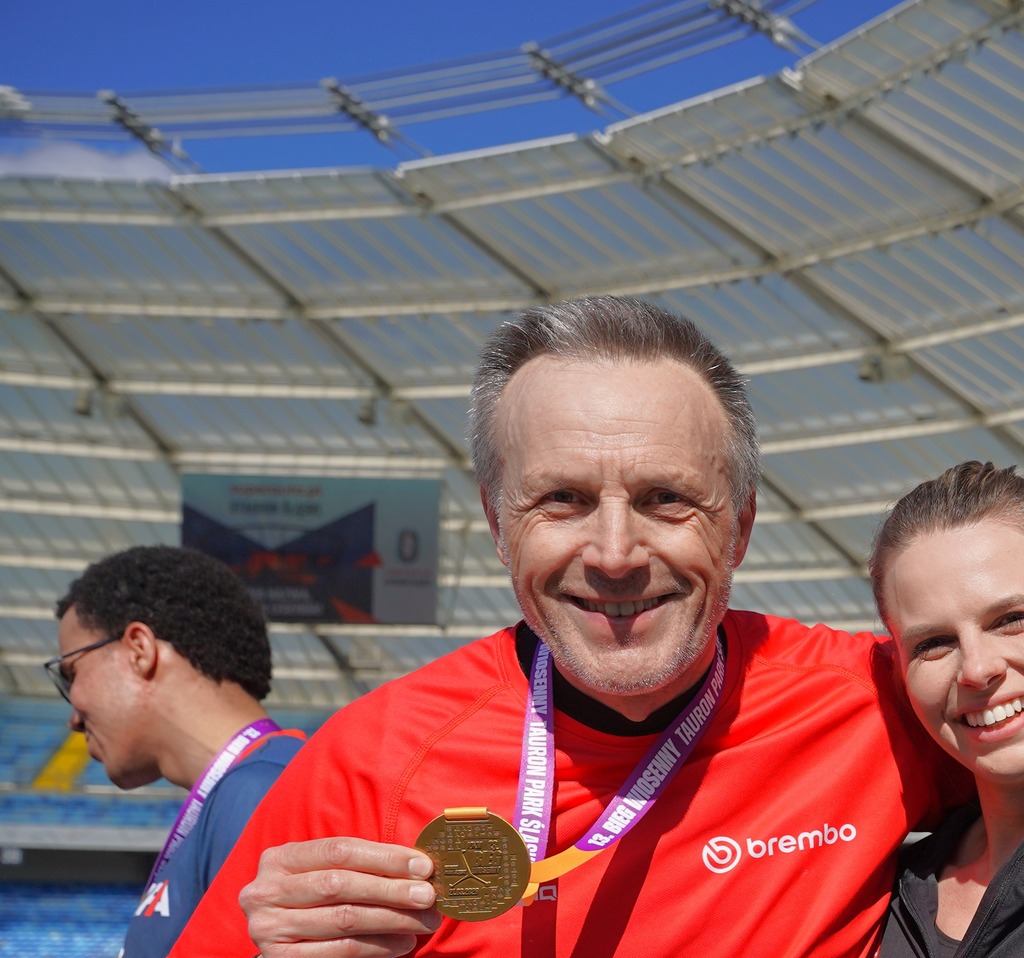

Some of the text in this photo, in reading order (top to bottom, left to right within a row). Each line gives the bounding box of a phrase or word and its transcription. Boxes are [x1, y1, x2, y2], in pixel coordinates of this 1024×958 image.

[526, 721, 548, 775] TAURON
[588, 831, 615, 847] 13.
[602, 804, 636, 836] BIEG
[622, 738, 682, 808] WIOSENNY
[674, 693, 717, 746] TAURON
[521, 775, 546, 818] PARK
[746, 823, 857, 858] brembo
